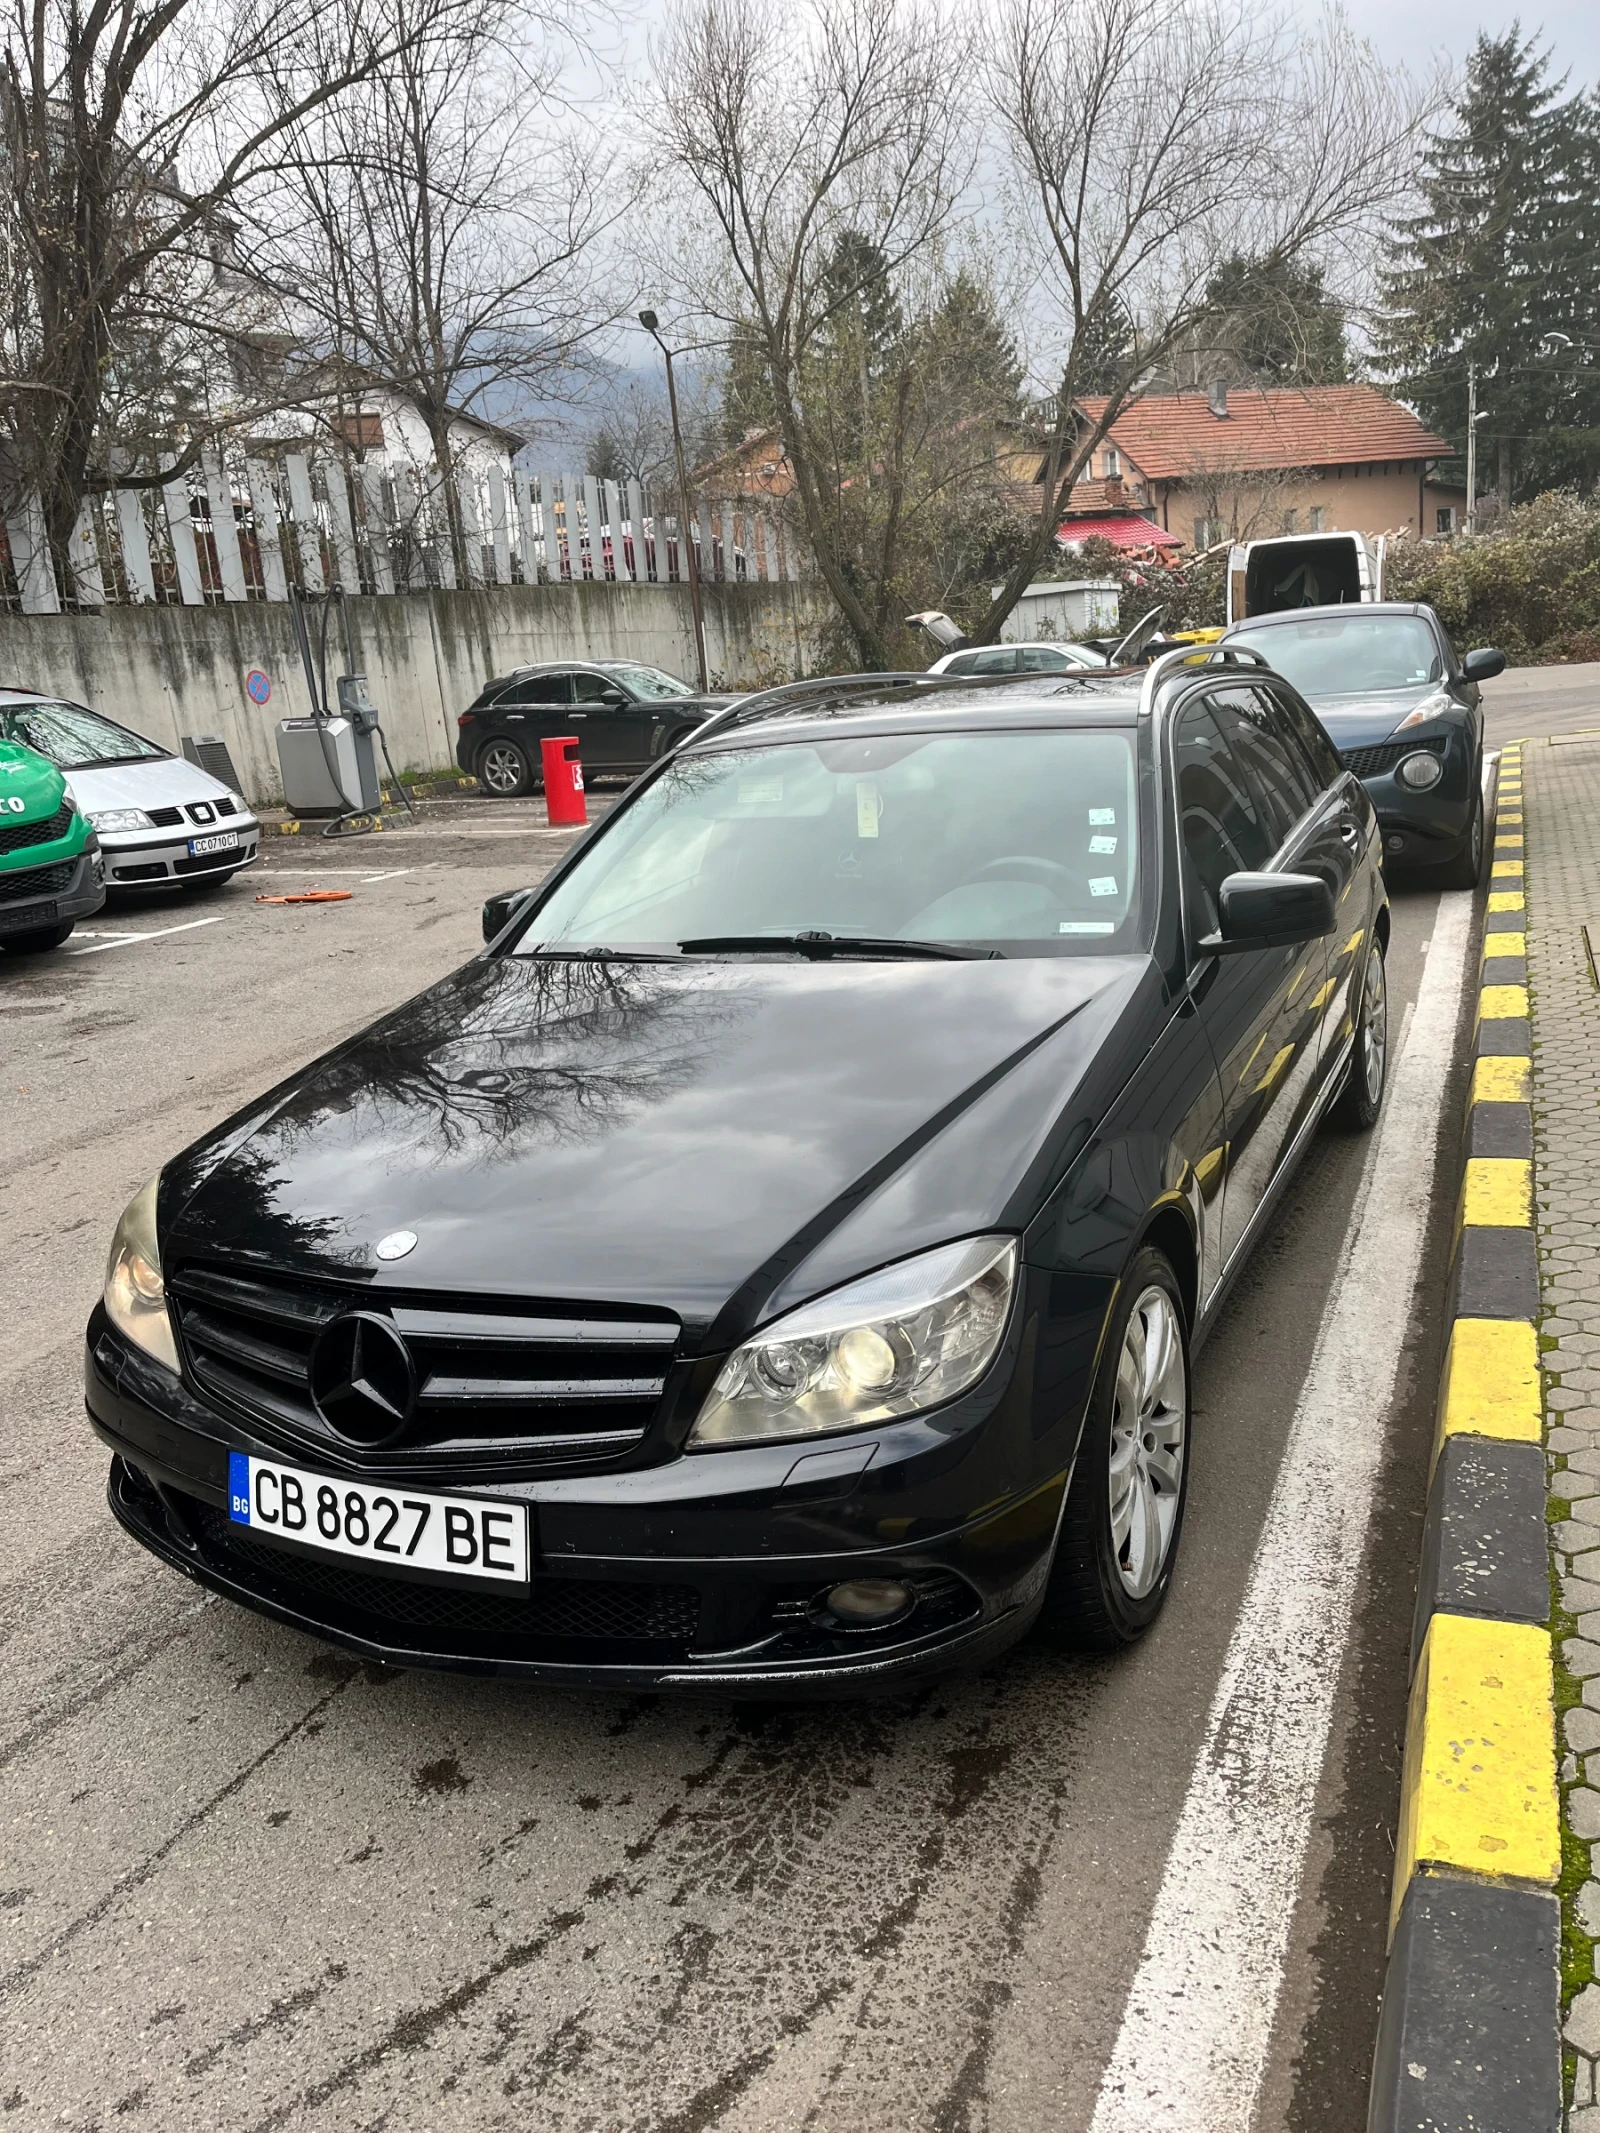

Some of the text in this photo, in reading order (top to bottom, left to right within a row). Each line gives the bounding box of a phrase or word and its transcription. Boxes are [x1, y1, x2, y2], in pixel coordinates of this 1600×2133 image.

[195, 834, 236, 852] CC 0710 CT
[232, 1496, 249, 1515] BG
[255, 1468, 515, 1572] CB 8827 BE
